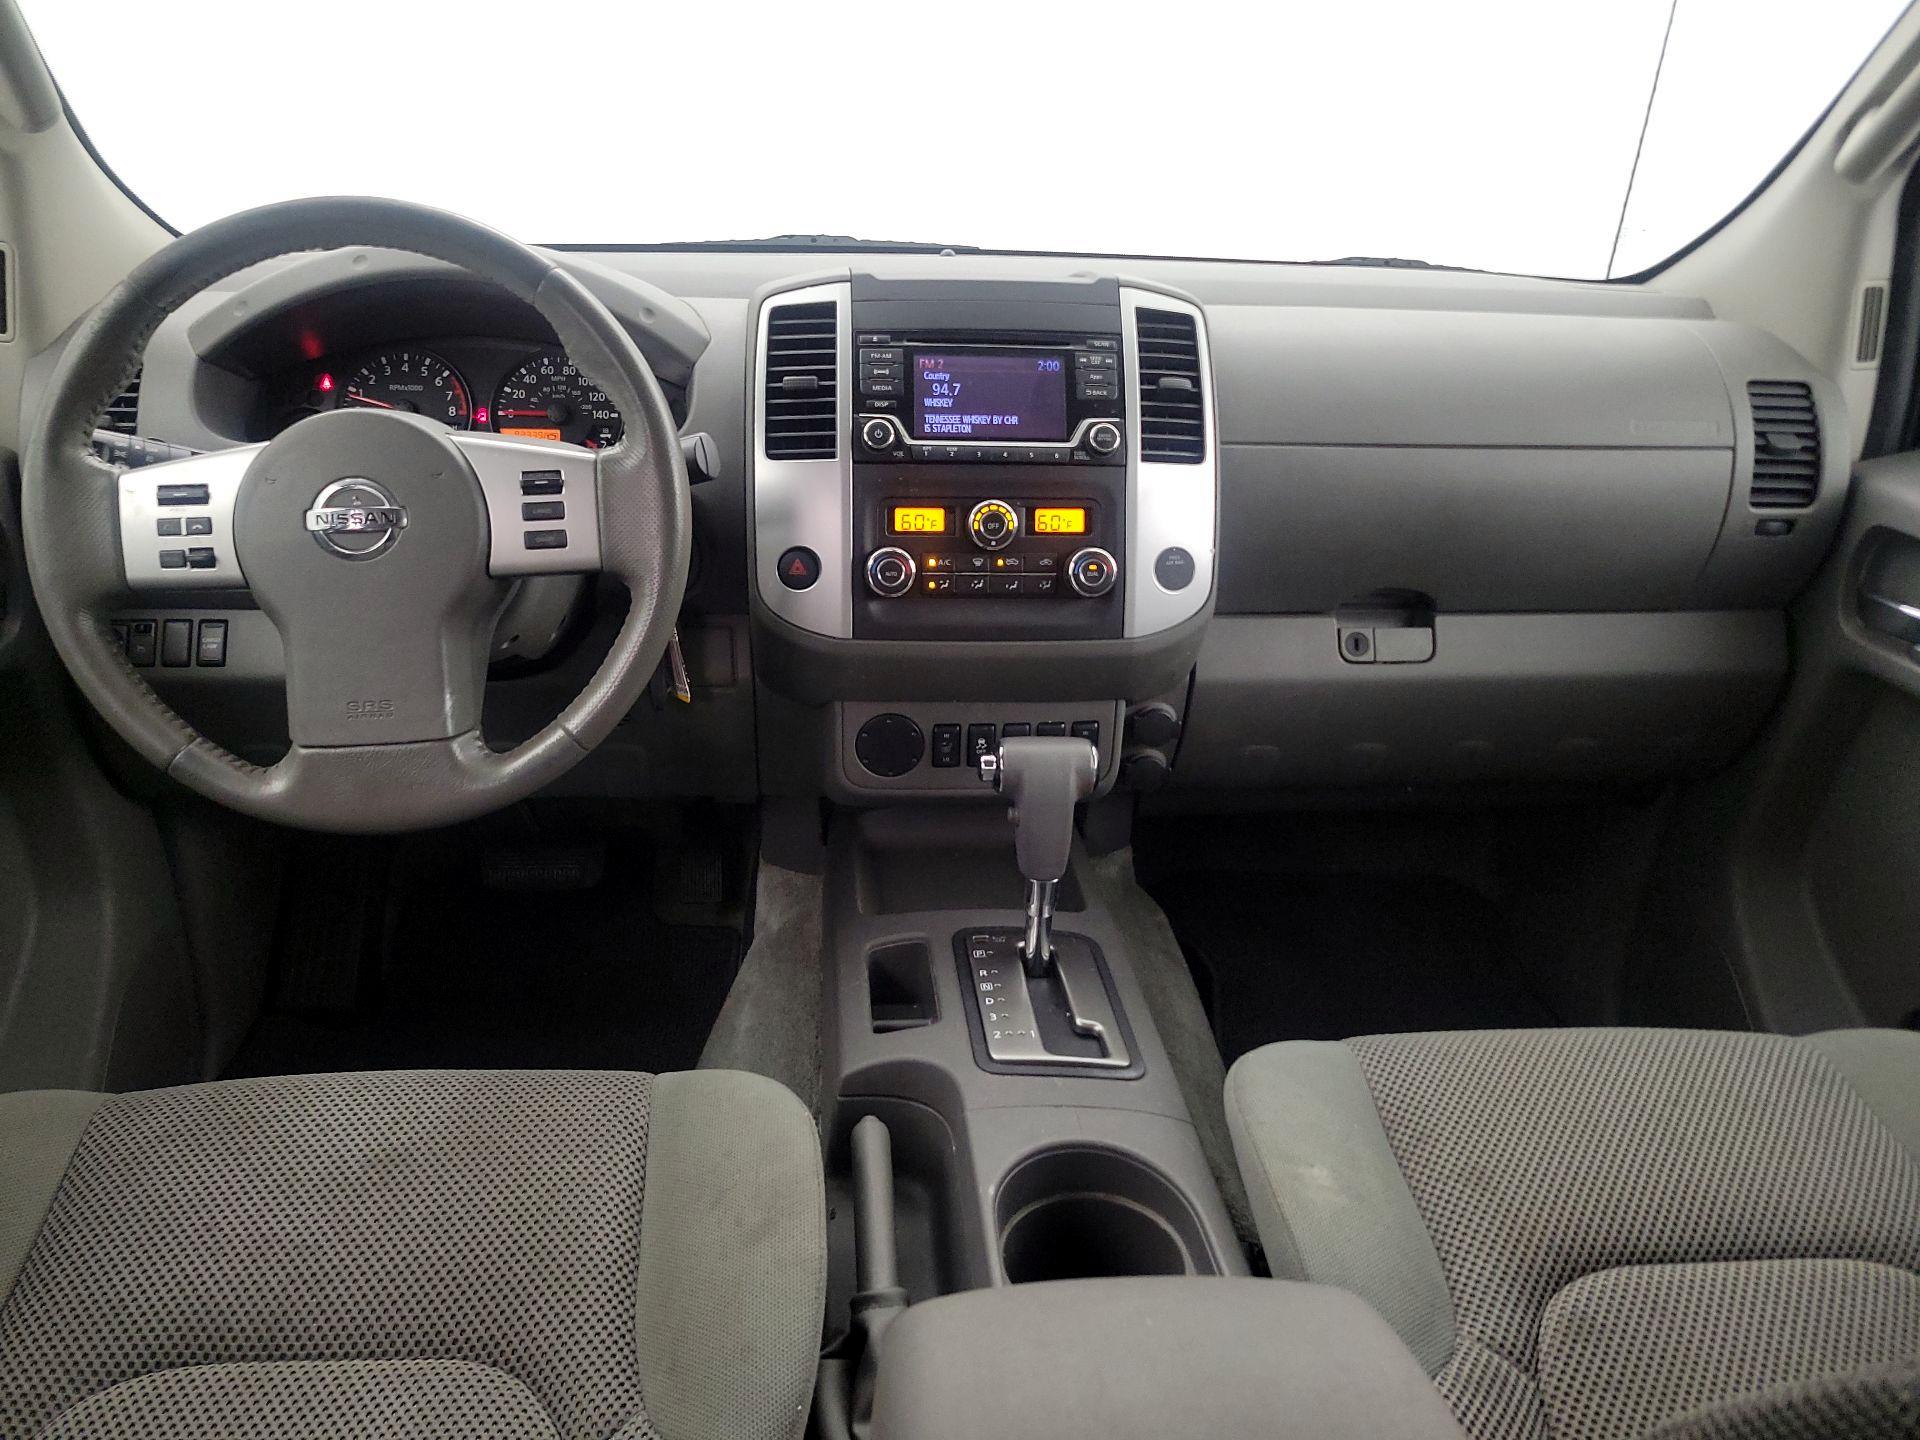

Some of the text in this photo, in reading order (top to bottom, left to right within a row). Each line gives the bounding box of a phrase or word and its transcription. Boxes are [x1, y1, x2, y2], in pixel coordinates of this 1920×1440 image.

[401, 363, 409, 372] 4
[919, 359, 944, 369] FM 2
[1037, 361, 1060, 372] 2:00
[384, 365, 391, 376] 3
[421, 366, 429, 377] 5
[541, 366, 555, 375] 60
[563, 366, 576, 376] 80
[368, 375, 376, 385] 2
[523, 375, 537, 384] 40
[923, 371, 950, 381] Country
[435, 376, 443, 387] 6
[512, 389, 526, 399] 20
[932, 383, 961, 396] 94.7
[445, 391, 453, 402] 7
[589, 392, 606, 402] 120
[924, 398, 954, 408] WHISKEY
[448, 406, 457, 417] 8
[592, 410, 610, 420] 140
[924, 414, 1019, 425] TENNESSEE WHISKEY BY CHR
[933, 424, 971, 434] STAPLETON
[315, 511, 399, 525] NISSAN
[938, 559, 952, 567] A/C
[346, 699, 394, 711] SRS
[985, 997, 994, 1005] D
[989, 1013, 997, 1021] 3
[993, 1030, 1001, 1039] 2
